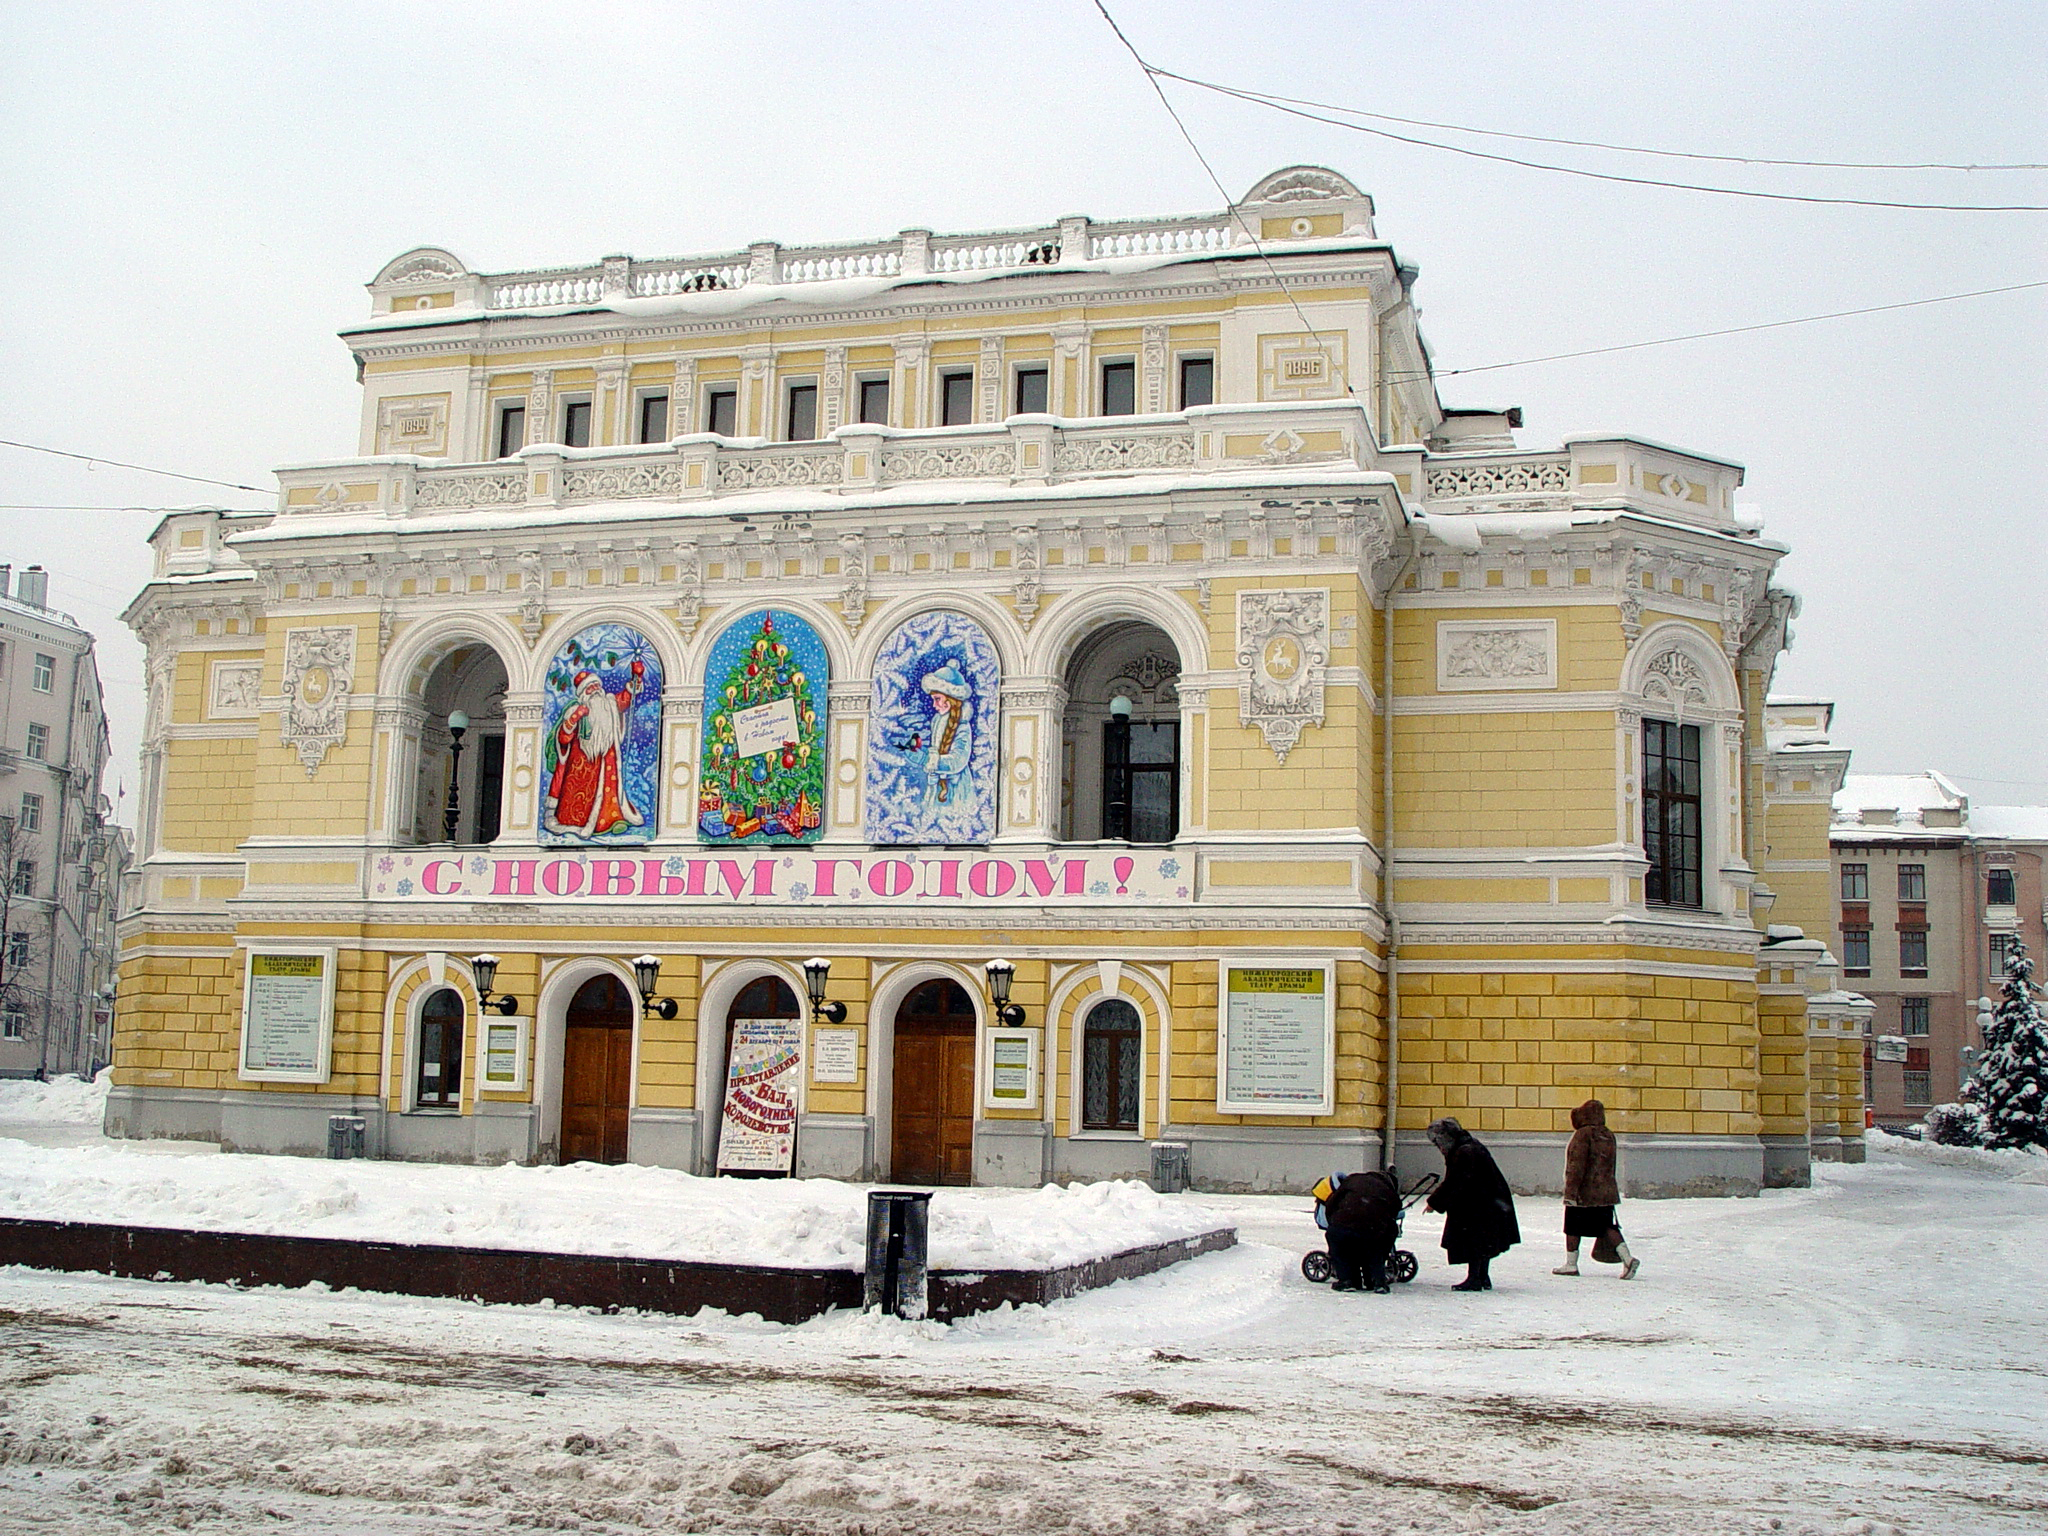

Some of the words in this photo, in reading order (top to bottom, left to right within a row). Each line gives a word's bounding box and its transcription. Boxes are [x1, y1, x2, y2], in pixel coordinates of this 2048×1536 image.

[1286, 360, 1320, 376] 1896
[399, 417, 428, 434] 1894
[421, 855, 464, 896] С
[489, 859, 778, 901] НОВЫМ
[740, 1035, 748, 1045] 24
[729, 1052, 801, 1088] ПРЕДСТАВЛЕНИЕ
